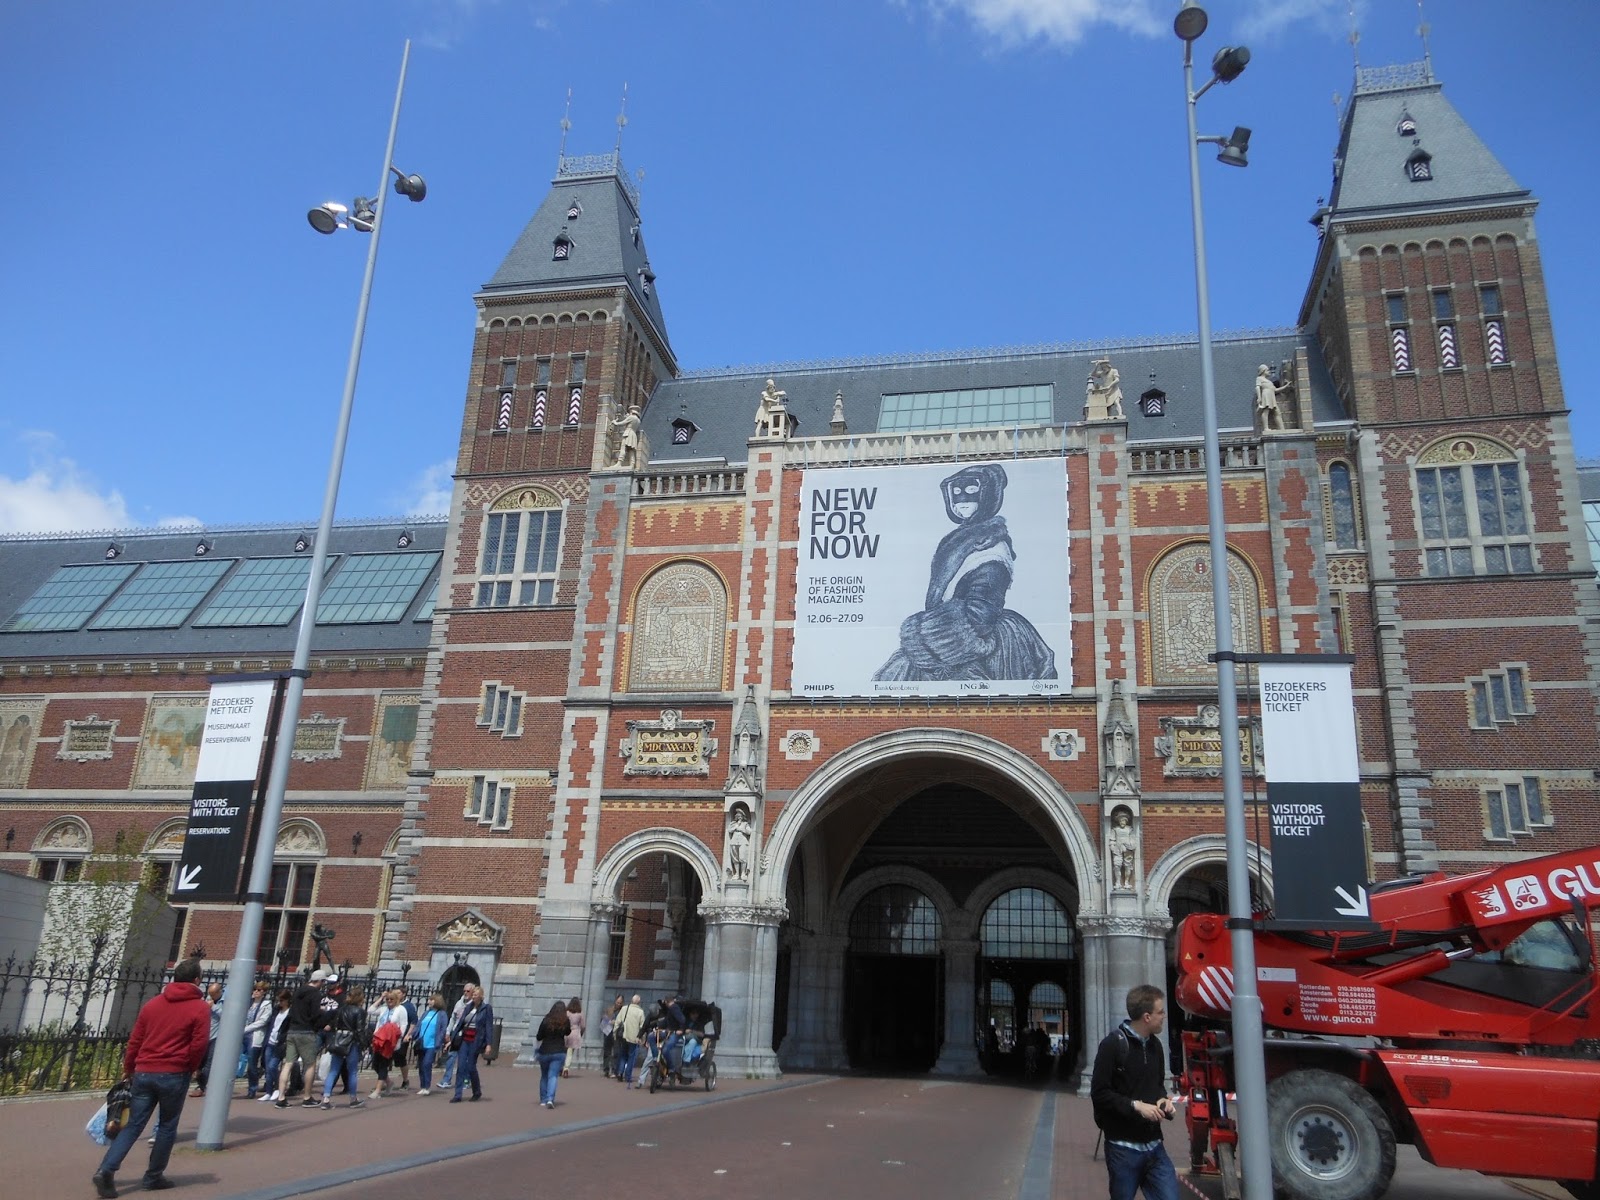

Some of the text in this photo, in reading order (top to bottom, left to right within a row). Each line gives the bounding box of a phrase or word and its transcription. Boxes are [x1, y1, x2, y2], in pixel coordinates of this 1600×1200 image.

[811, 487, 878, 512] NEW
[810, 511, 866, 536] FOR
[809, 534, 880, 560] NOW
[809, 576, 863, 586] THE ORIGIN
[808, 585, 866, 595] OF FASHION
[808, 594, 864, 604] MAGAZINES
[1264, 682, 1327, 692] BEZOEKERS
[211, 697, 254, 707] BEZOEKERS
[1265, 692, 1310, 702] ZONDER
[210, 706, 253, 715] MET TICKET
[1265, 703, 1302, 712] TICKET
[207, 722, 250, 731] MUSEUMKAART
[205, 736, 251, 744] RESERVERINGEN
[194, 799, 228, 808] VISITORS
[192, 807, 240, 817] WITH TICKET
[1271, 804, 1323, 814] VISITORS
[1272, 815, 1326, 825] WITHOUT
[188, 827, 231, 835] RESERVATIONS
[1273, 826, 1312, 836] TICKET
[1303, 1014, 1374, 1024] www.gunco.nl
